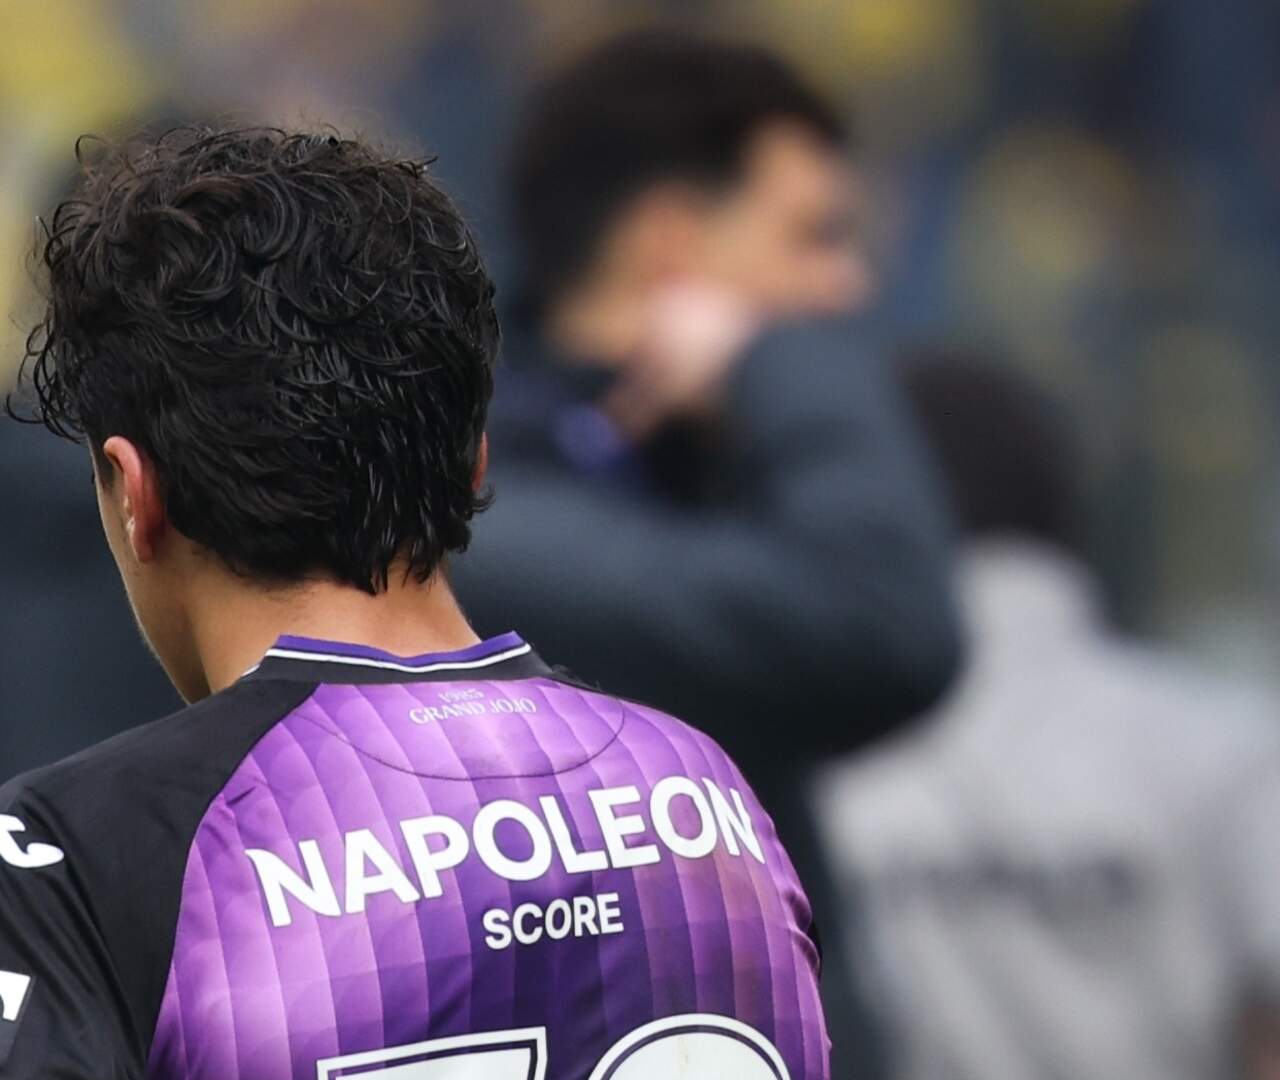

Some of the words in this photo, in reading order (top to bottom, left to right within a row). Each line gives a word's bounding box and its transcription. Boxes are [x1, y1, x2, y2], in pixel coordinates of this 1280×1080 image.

[409, 702, 486, 724] GRAND
[490, 698, 537, 713] JOJO
[245, 775, 765, 927] NAPOLEON
[482, 892, 624, 950] SCORE
